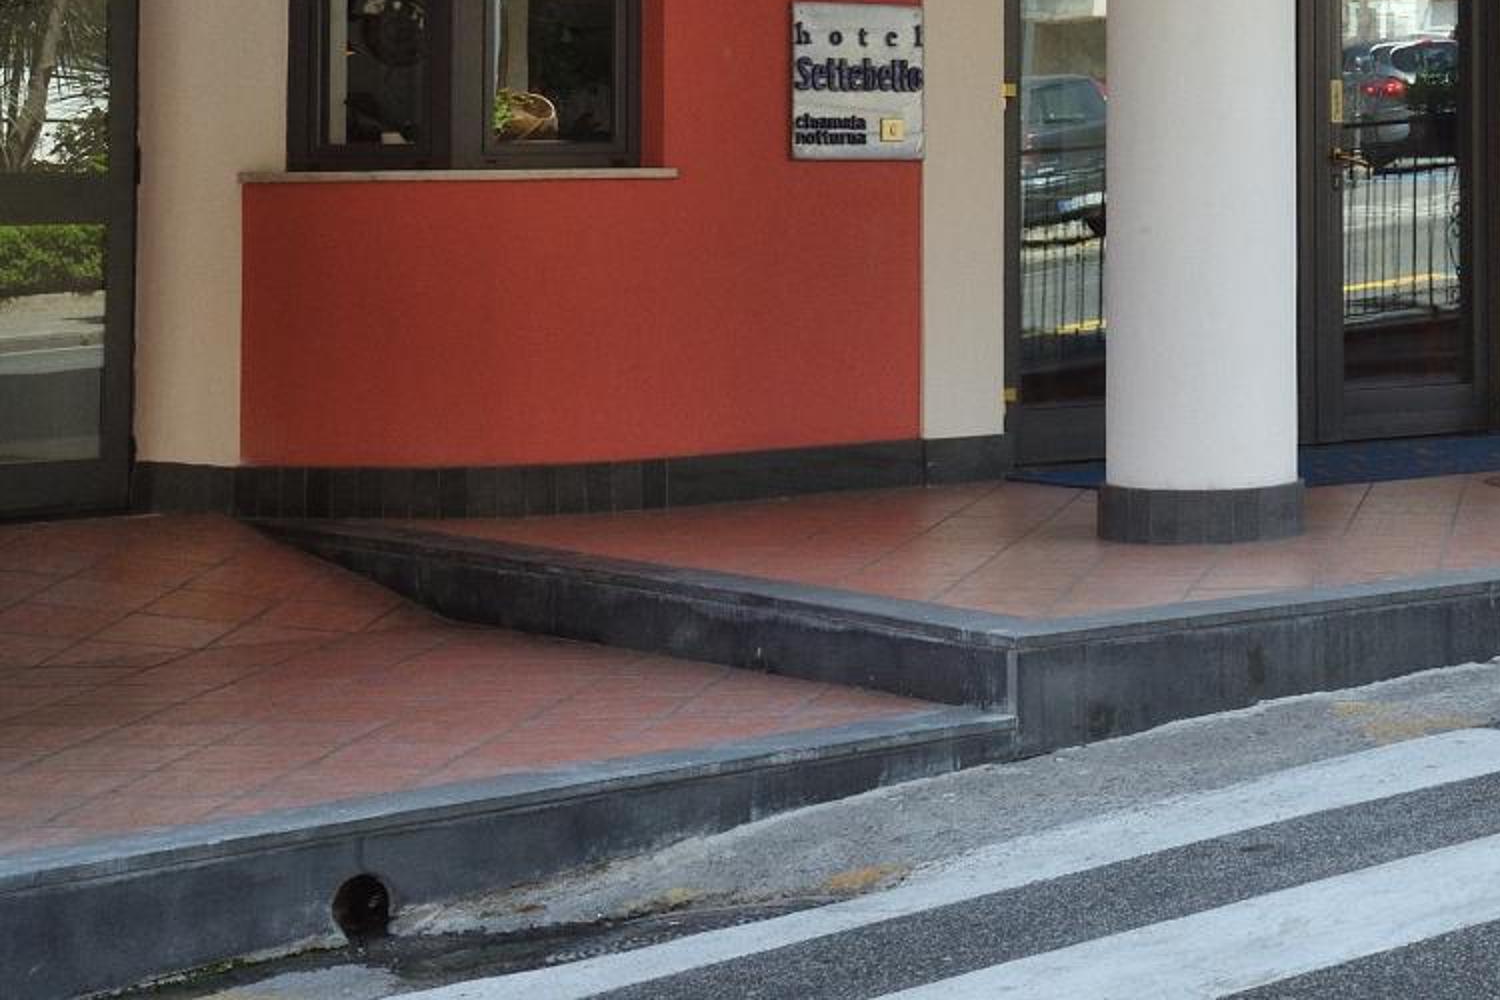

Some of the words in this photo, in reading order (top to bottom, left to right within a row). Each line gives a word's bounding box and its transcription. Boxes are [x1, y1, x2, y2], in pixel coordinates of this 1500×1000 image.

[794, 21, 924, 47] hotel
[793, 56, 925, 92] Settebello
[794, 130, 867, 145] notturna
